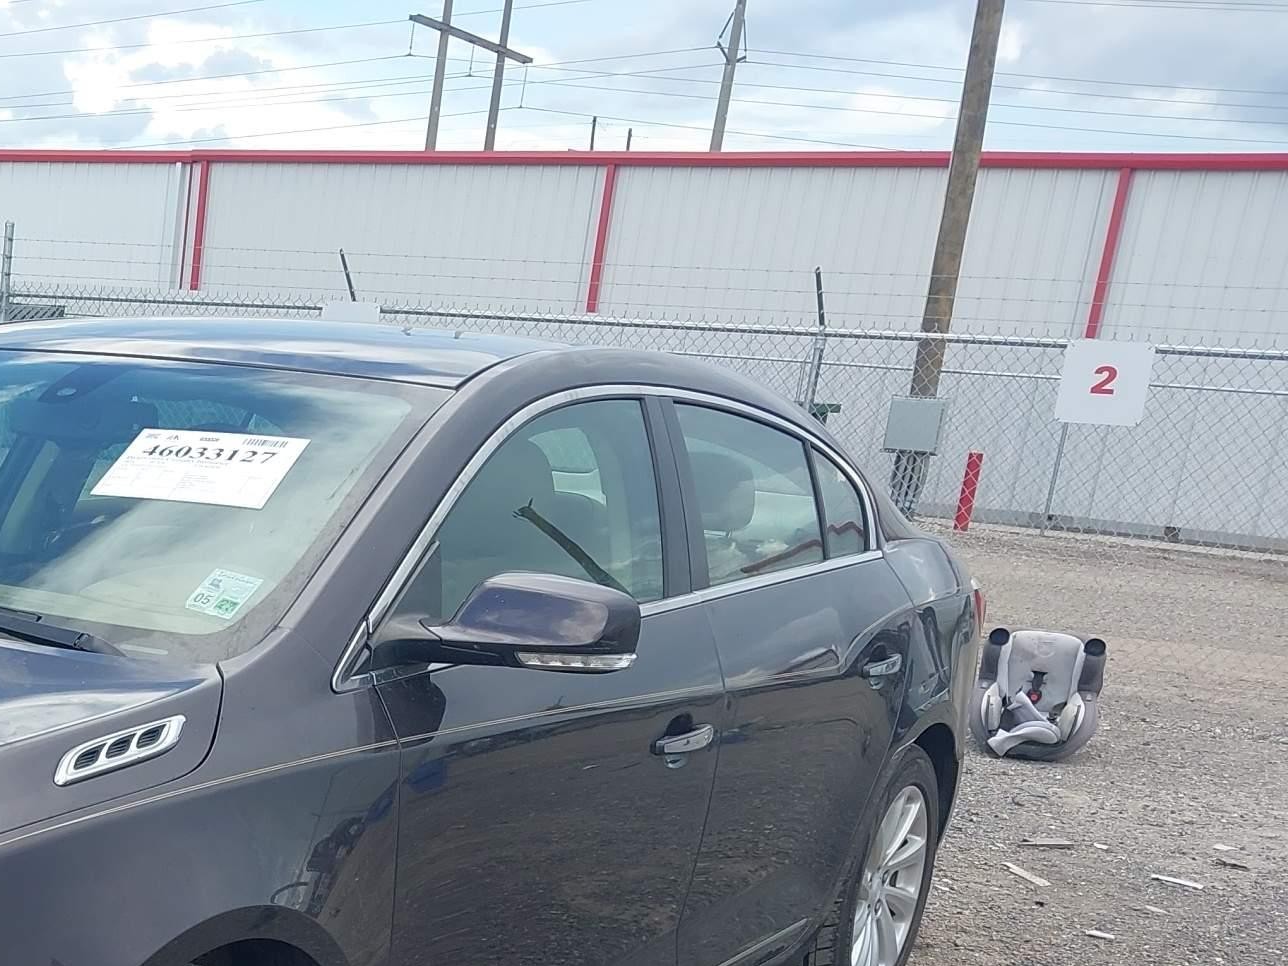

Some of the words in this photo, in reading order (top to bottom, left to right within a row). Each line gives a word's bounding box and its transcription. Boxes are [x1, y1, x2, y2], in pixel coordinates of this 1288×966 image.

[1090, 365, 1118, 395] 2
[142, 444, 278, 464] 46033127
[194, 593, 215, 605] 05
